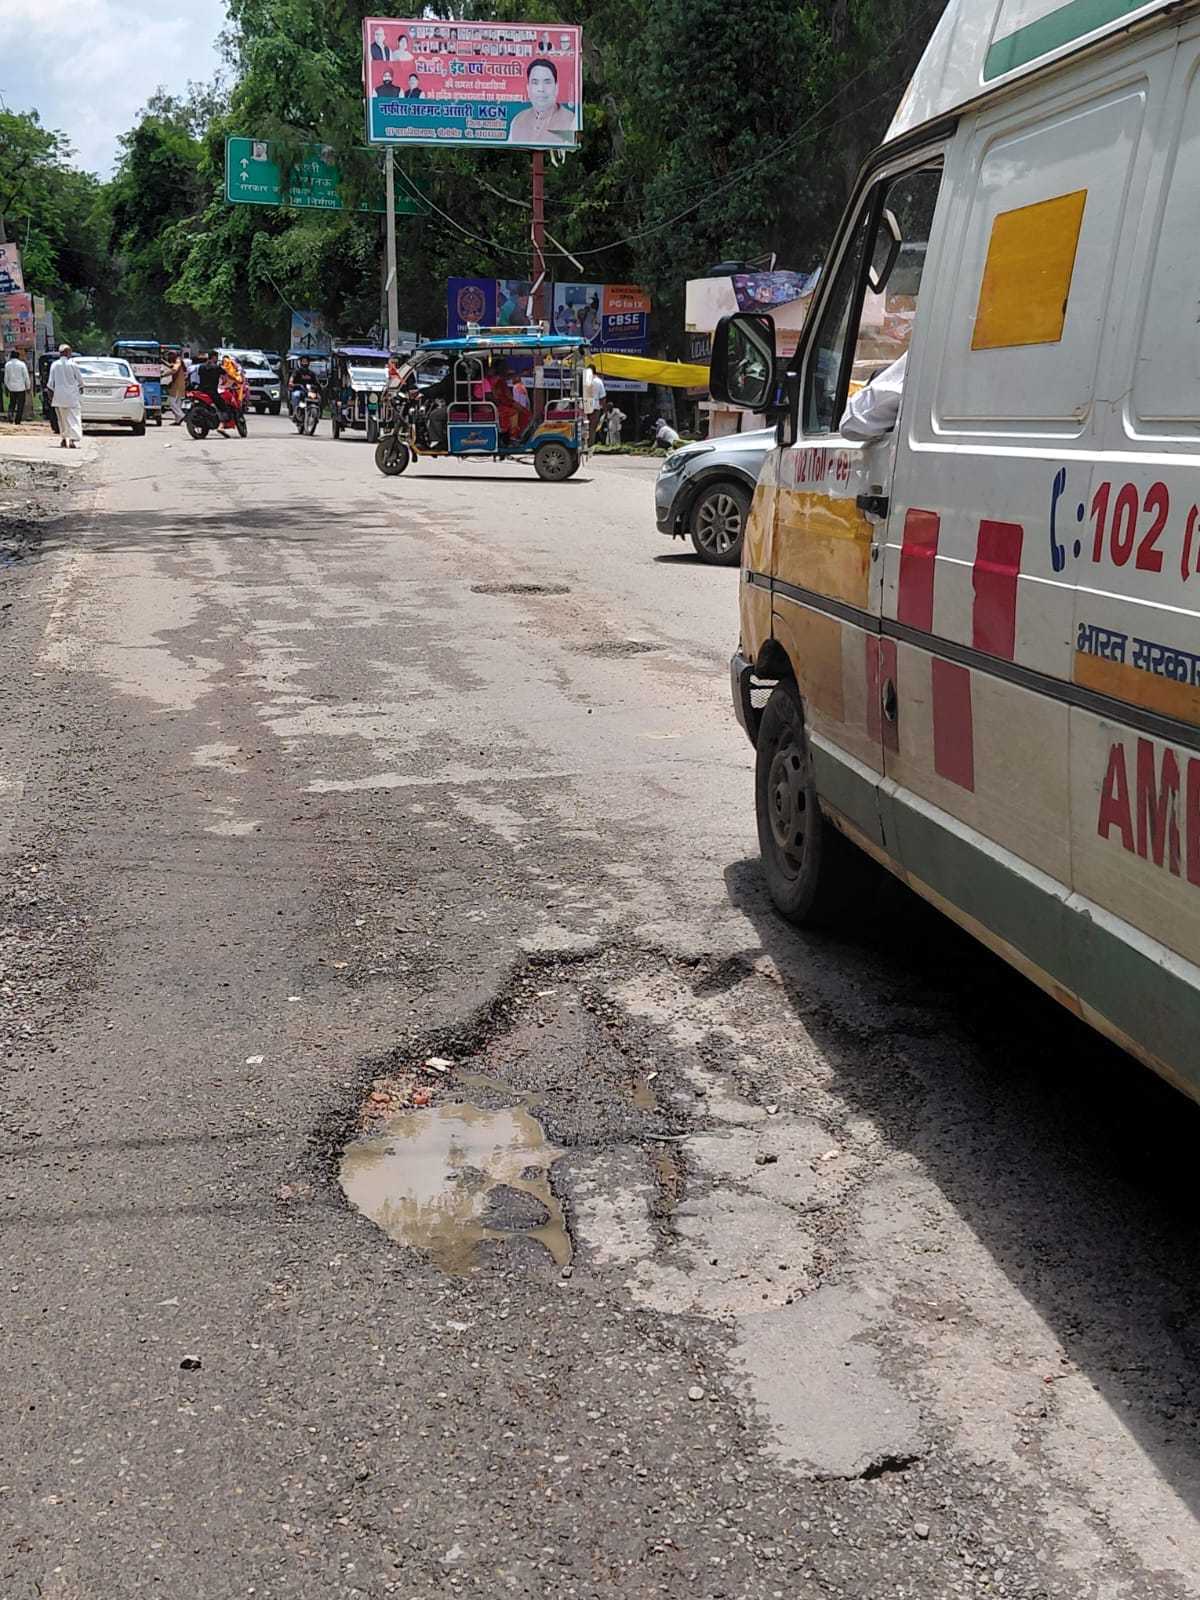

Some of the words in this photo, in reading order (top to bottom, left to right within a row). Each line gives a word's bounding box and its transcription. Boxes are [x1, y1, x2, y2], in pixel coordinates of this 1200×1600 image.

[467, 60, 486, 75] एवं
[486, 61, 523, 77] नवरात्रि
[379, 102, 409, 115] नफीस
[410, 104, 441, 117] अहमद
[443, 104, 473, 117] अंसारी
[479, 106, 507, 118] KGN
[608, 300, 622, 308] PG
[623, 300, 633, 308] to
[608, 314, 640, 326] CBSE
[1089, 481, 1170, 574] 102
[1079, 622, 1128, 665] भारत
